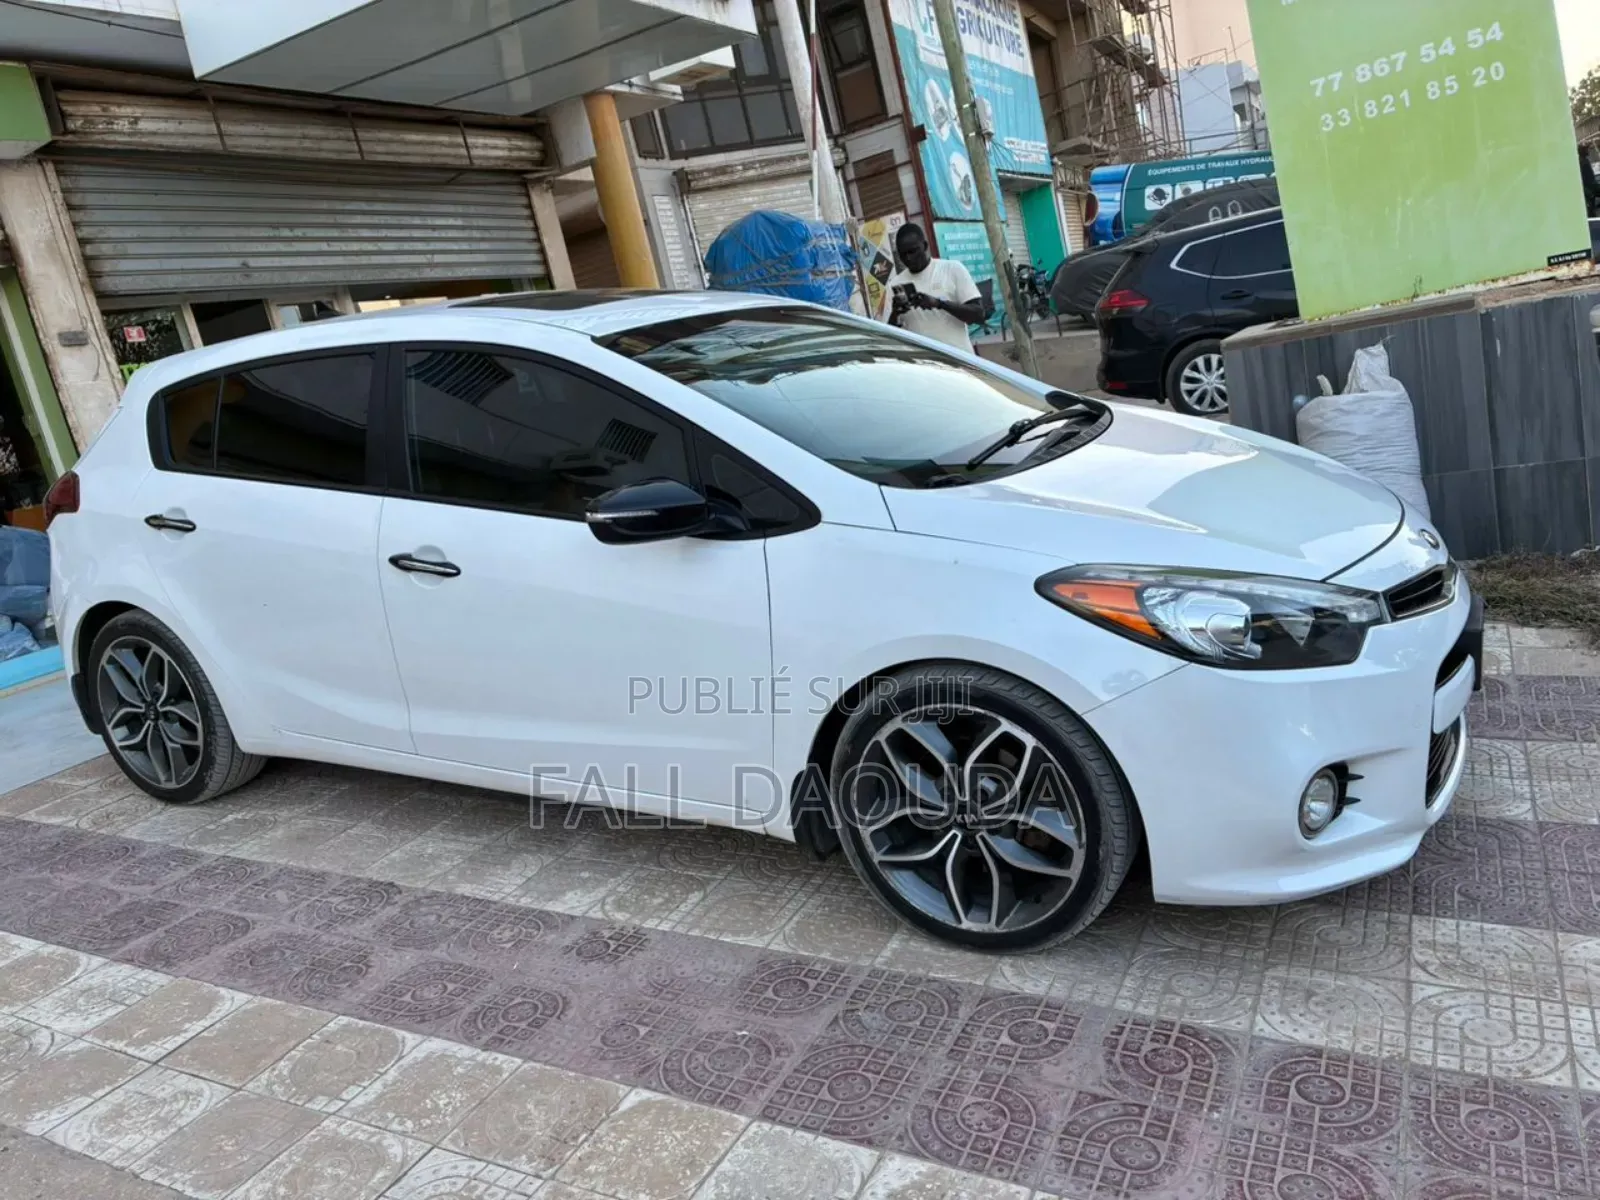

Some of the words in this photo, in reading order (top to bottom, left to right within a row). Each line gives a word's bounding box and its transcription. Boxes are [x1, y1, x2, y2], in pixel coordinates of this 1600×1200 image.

[956, 6, 1025, 58] GRICULTURE
[1309, 71, 1343, 97] 77
[1355, 50, 1407, 83] 867
[1419, 36, 1456, 63] 54
[1466, 20, 1504, 48] 54
[1320, 108, 1351, 131] 33
[1363, 88, 1411, 118] 821
[1426, 75, 1459, 100] 85
[1472, 61, 1505, 87] 20
[1196, 163, 1206, 171] DE
[1207, 160, 1240, 169] TRAVAUX
